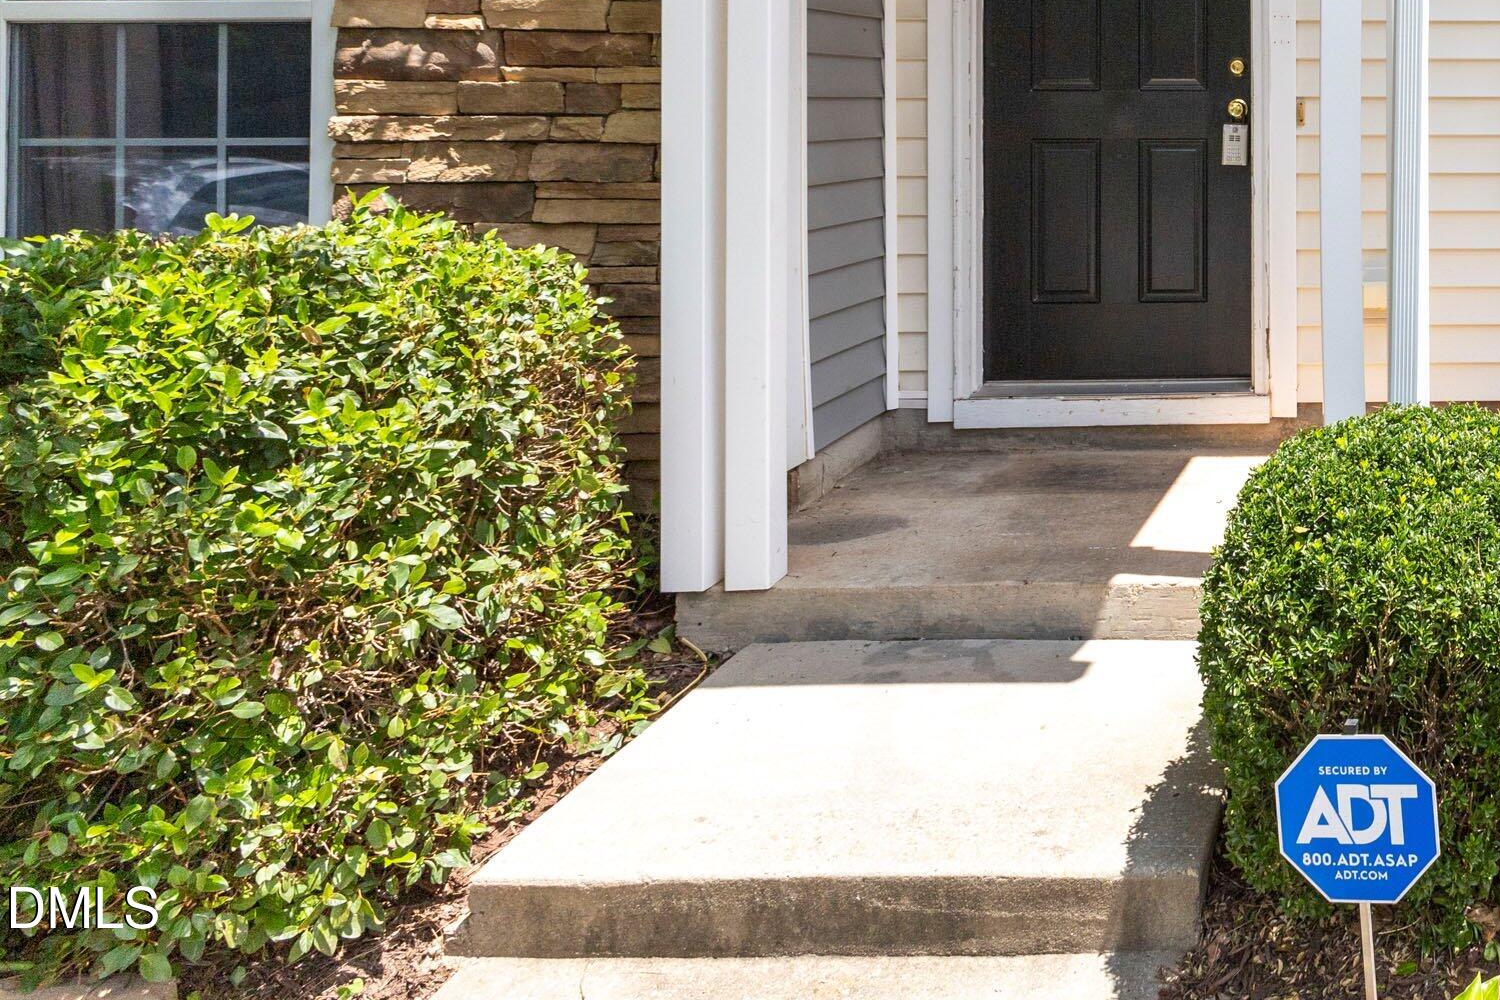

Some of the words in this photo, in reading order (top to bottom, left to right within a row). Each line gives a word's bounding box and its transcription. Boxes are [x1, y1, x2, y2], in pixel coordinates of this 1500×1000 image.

[1318, 766, 1371, 776] SECURED
[1373, 766, 1388, 776] BY
[1296, 784, 1418, 846] ADT
[1302, 852, 1418, 868] 800.ADT.ASAP
[1334, 870, 1389, 881] ADT.COM
